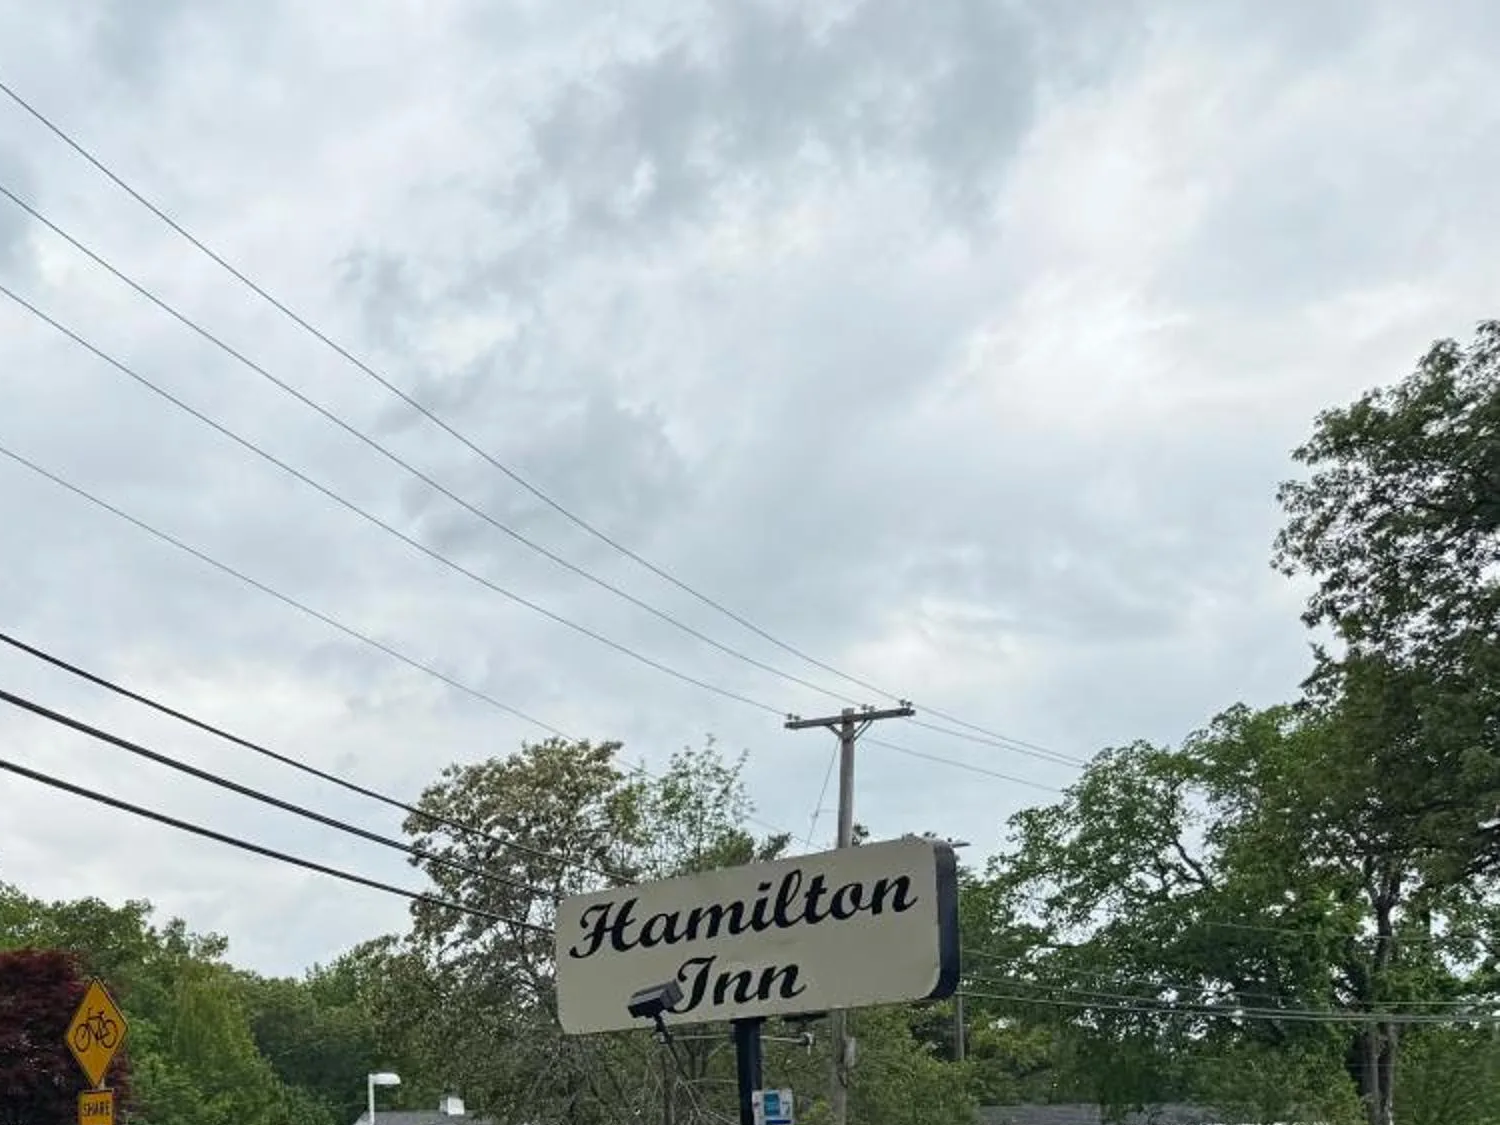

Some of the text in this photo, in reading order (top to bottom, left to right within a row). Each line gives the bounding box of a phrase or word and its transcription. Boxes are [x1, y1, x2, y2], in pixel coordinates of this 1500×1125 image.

[569, 869, 918, 959] Hamilton
[670, 954, 805, 1014] Inn
[83, 1102, 110, 1117] SHARE
